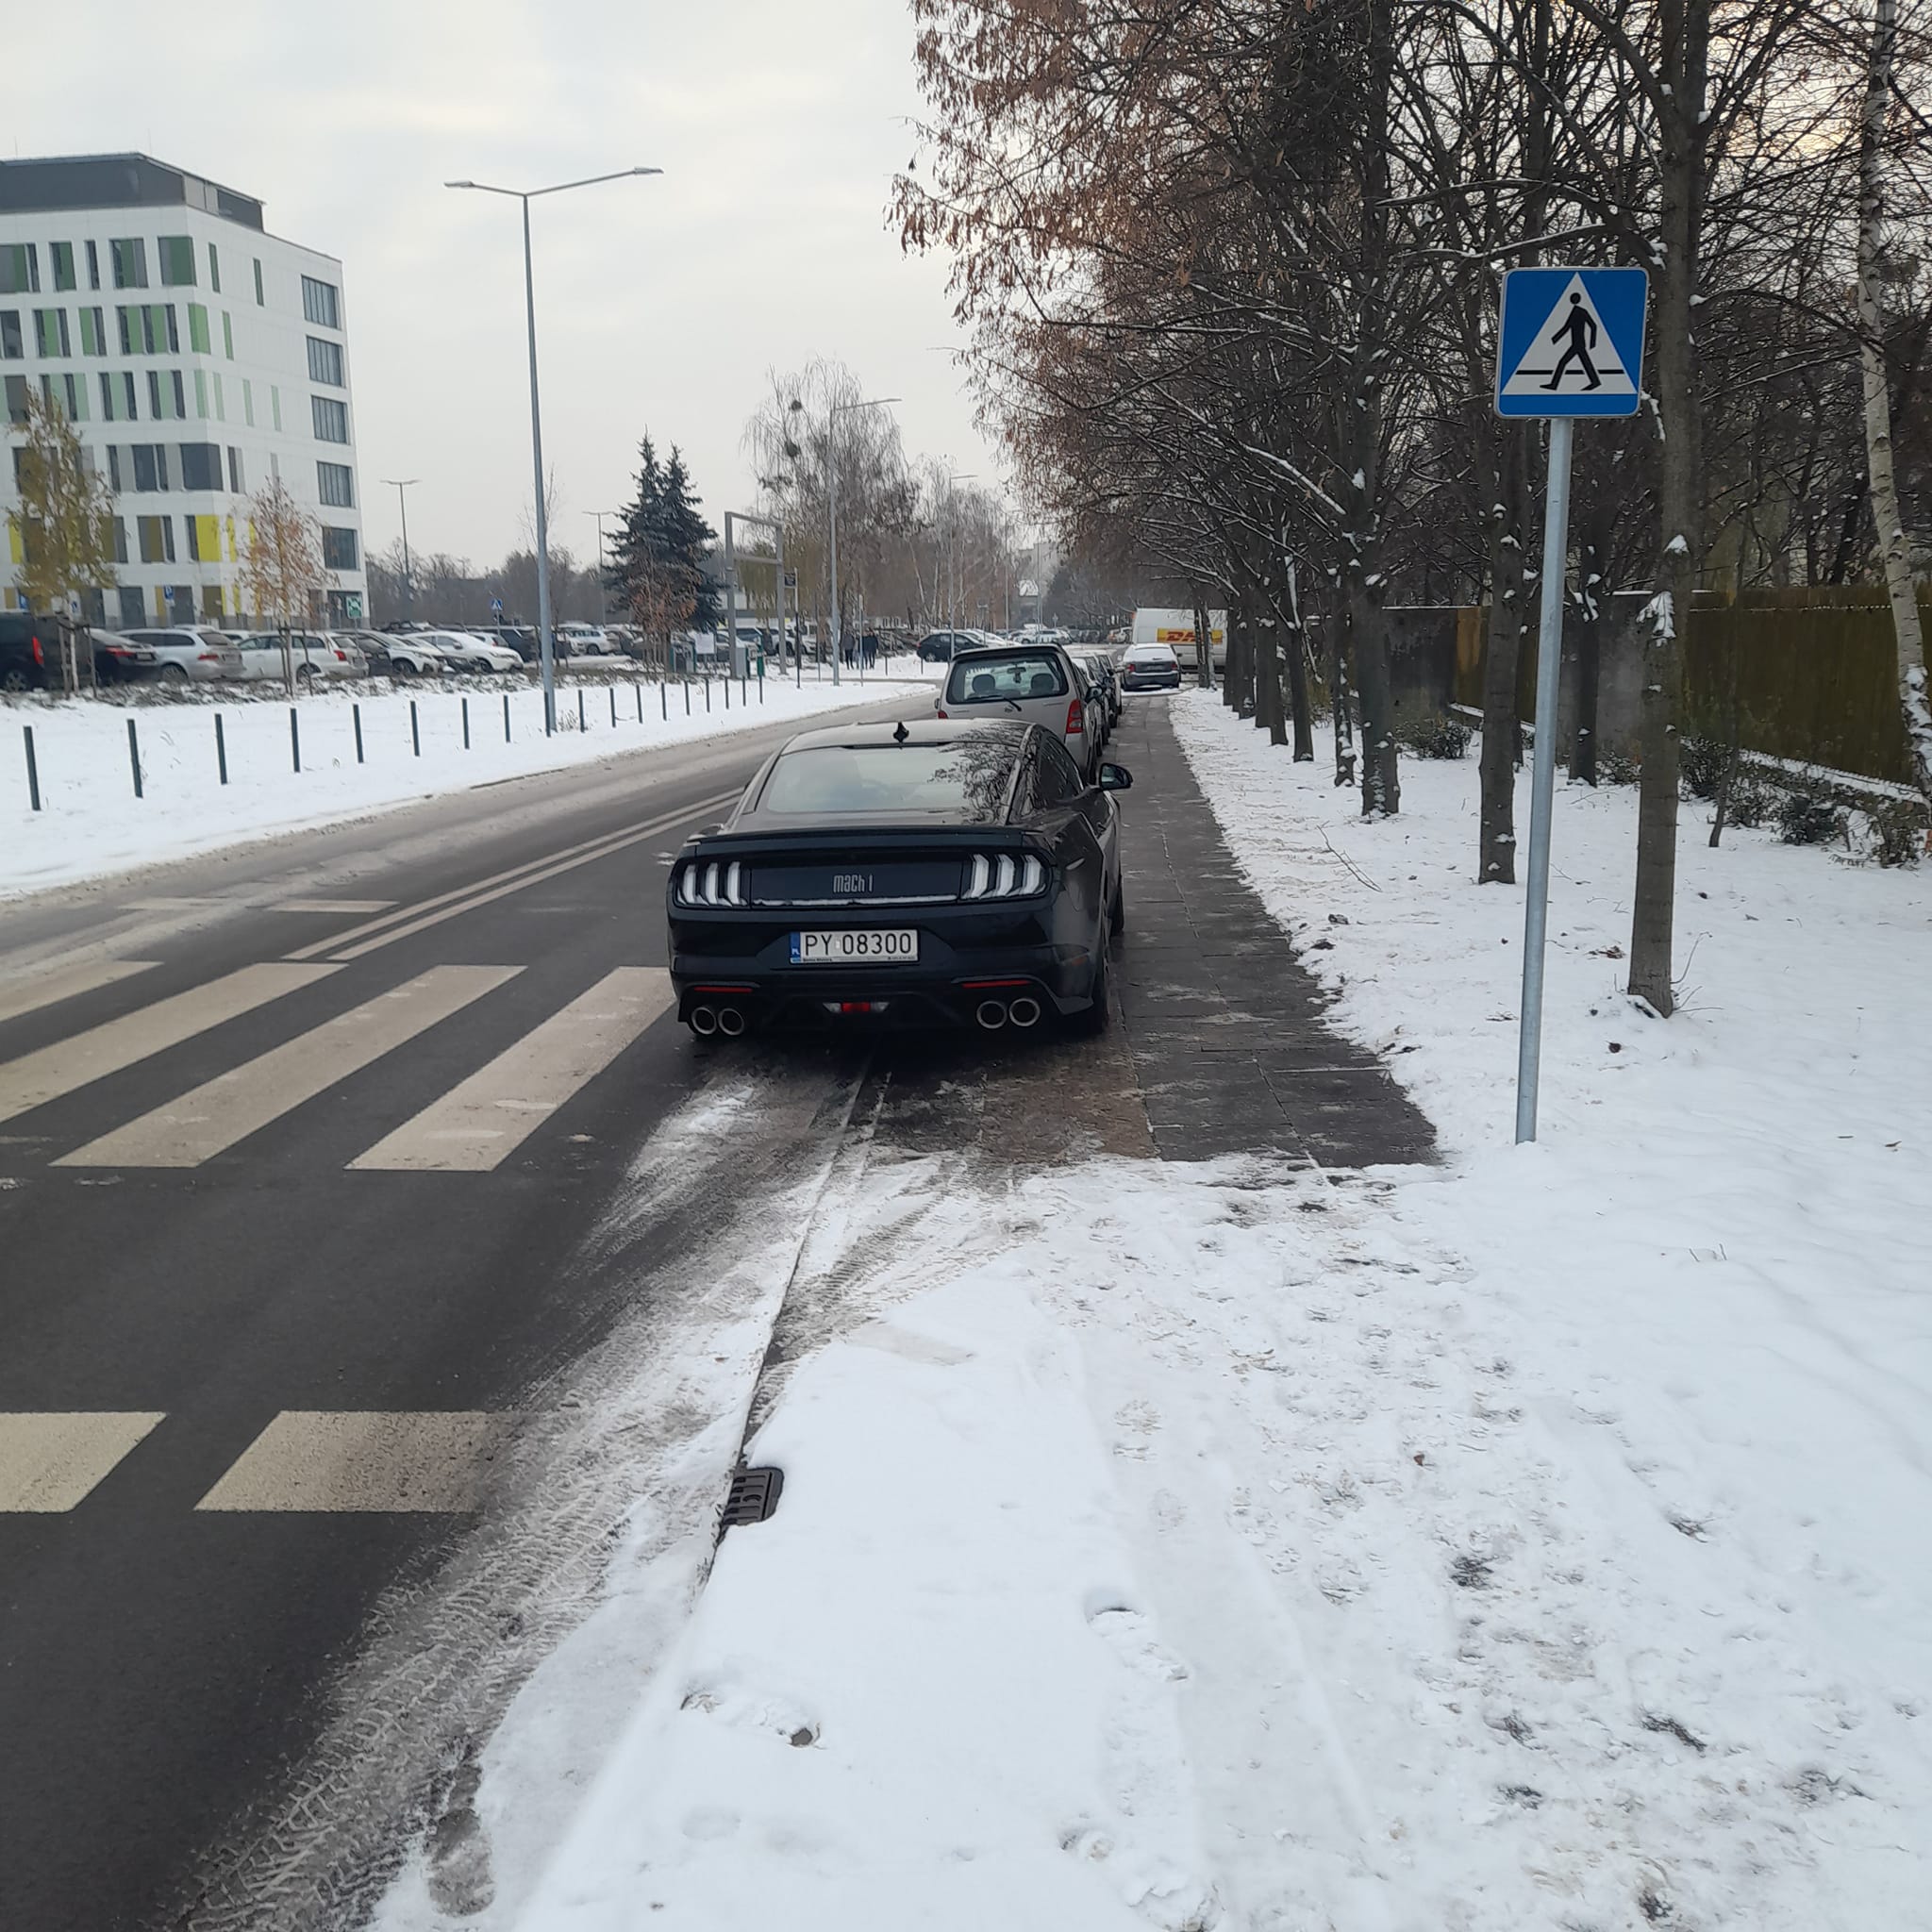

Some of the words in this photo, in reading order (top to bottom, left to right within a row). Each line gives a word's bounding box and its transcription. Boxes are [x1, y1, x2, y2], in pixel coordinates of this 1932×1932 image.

[1166, 631, 1207, 642] DH
[805, 934, 832, 956] PY
[842, 933, 911, 955] 08300
